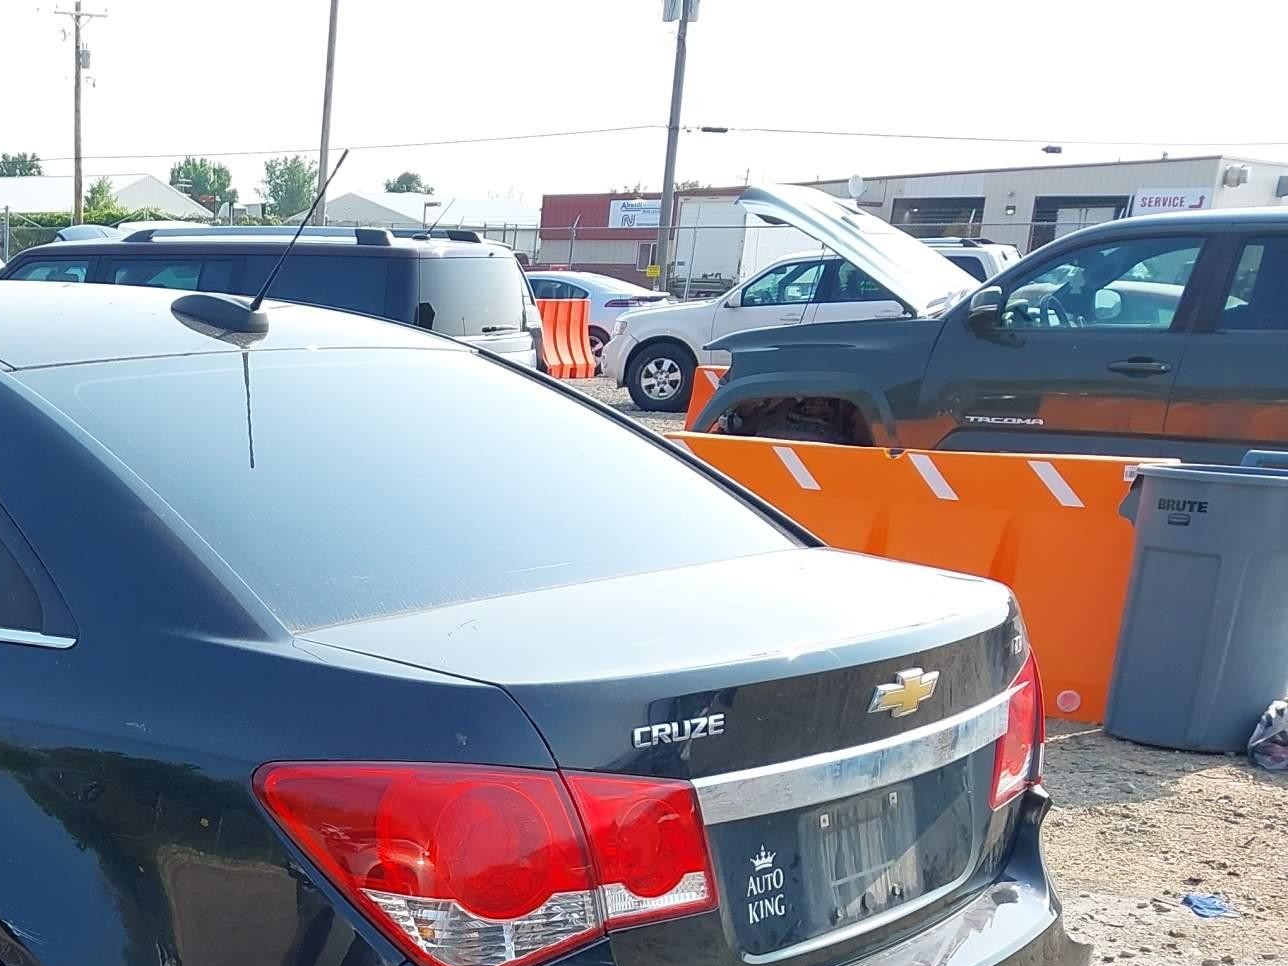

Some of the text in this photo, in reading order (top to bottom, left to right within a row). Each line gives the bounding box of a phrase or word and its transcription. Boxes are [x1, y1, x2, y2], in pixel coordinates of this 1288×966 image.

[1140, 196, 1186, 208] SERVICE
[965, 415, 1044, 425] TACOMA
[1158, 498, 1209, 513] BRUTE
[633, 713, 726, 749] CRUZE
[747, 868, 784, 898] AUTO
[748, 893, 786, 924] KING
